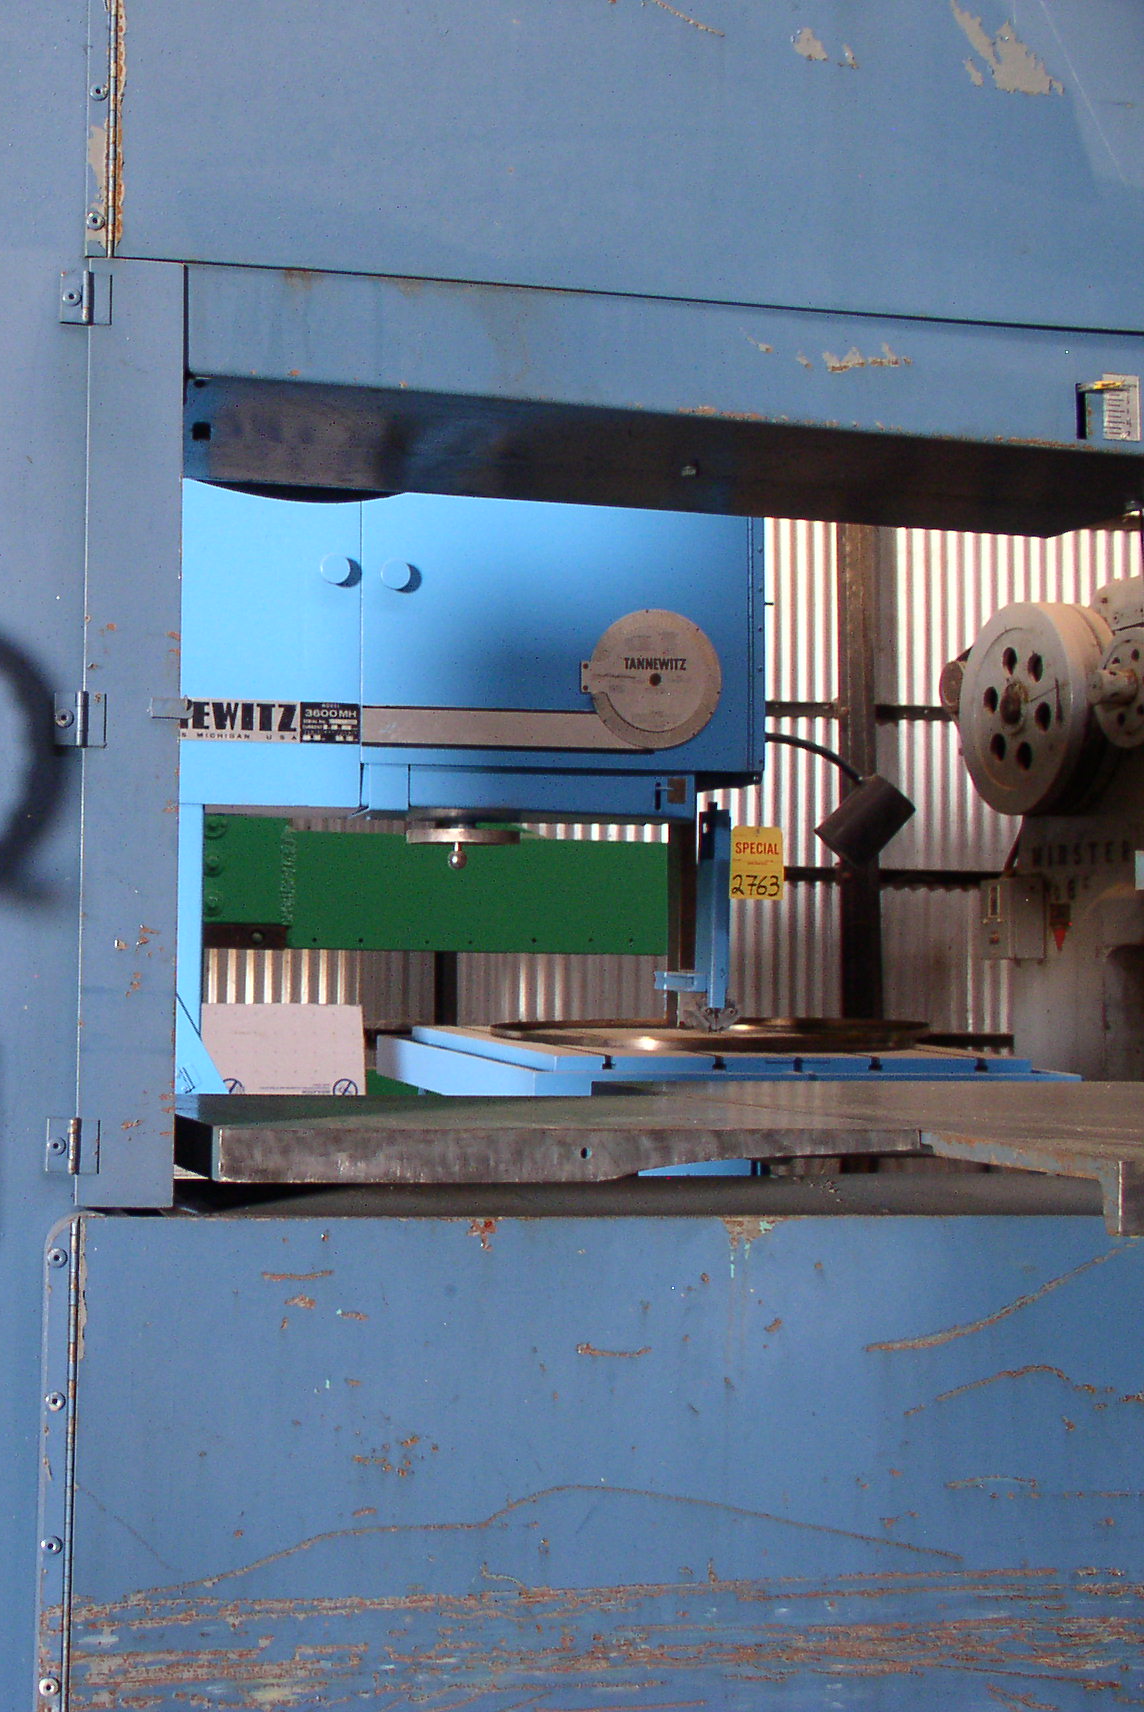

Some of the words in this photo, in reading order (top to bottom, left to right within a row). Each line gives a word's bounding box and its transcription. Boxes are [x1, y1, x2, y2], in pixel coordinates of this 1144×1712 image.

[624, 657, 687, 671] TANNEWITZ
[735, 842, 780, 855] SPECIAL
[731, 874, 781, 897] 2763
